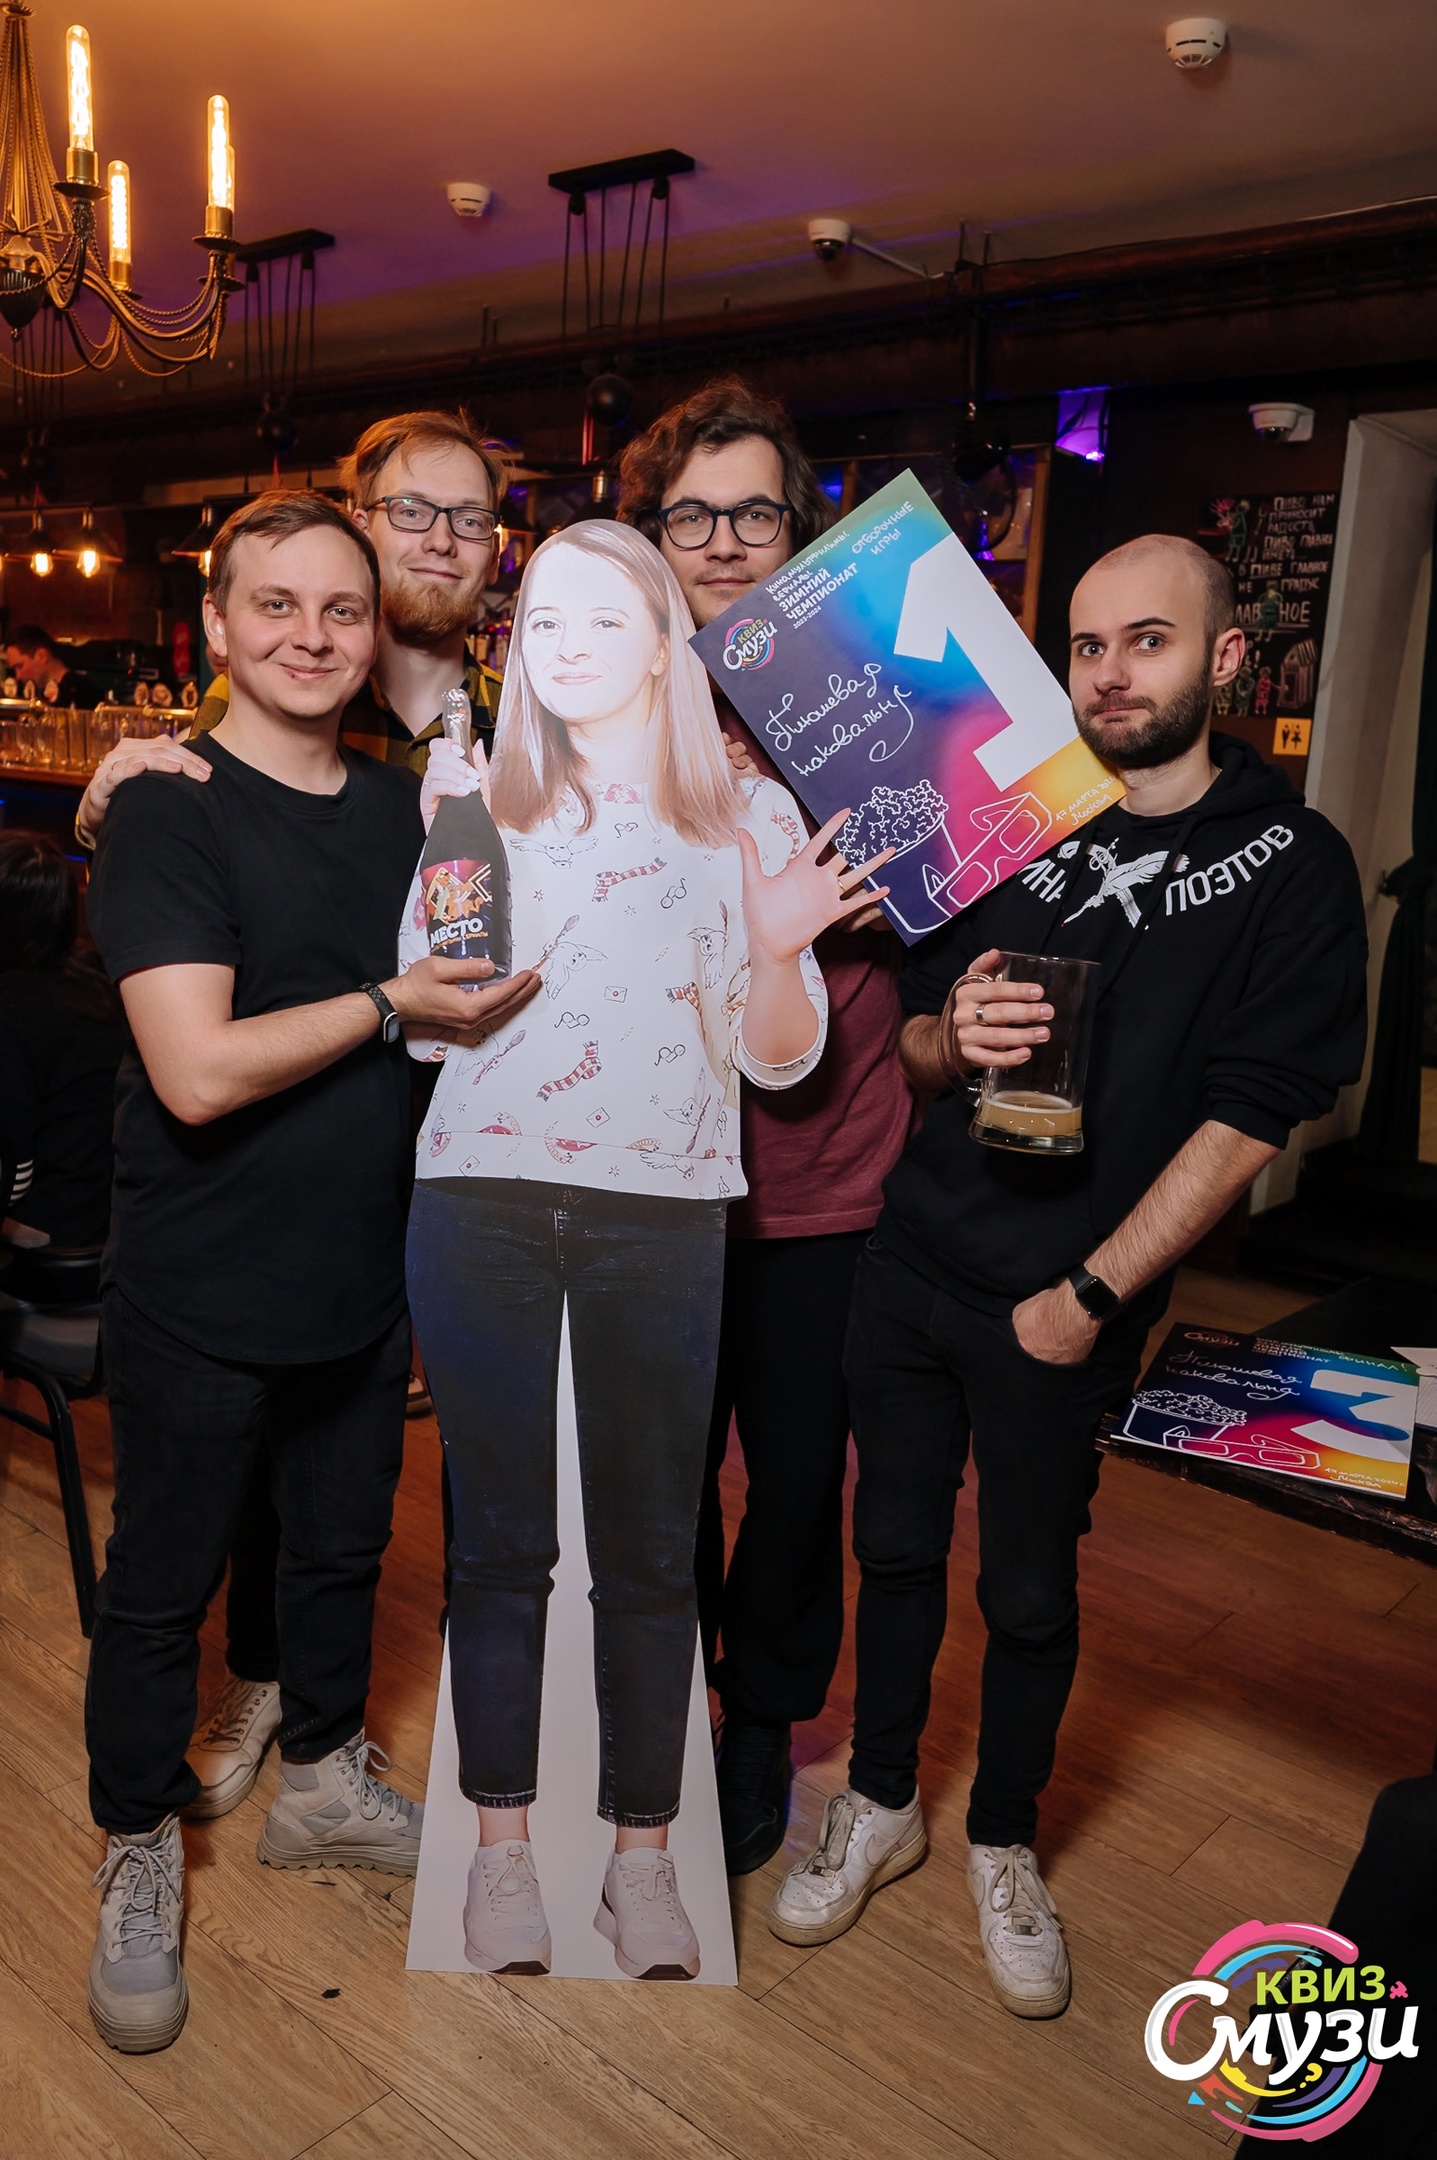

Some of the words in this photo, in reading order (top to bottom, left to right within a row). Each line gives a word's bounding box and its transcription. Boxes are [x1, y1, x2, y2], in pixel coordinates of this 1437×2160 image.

[850, 501, 915, 555] ОТБОРОЧНЫЕ
[870, 528, 903, 556] ИГРЫ
[776, 566, 832, 613] ЗИМНИЙ
[785, 562, 860, 622] ЧЕМПИОНАТ
[1238, 581, 1253, 593] НЕ
[1235, 600, 1312, 623] ЛАВНОЕ
[722, 619, 778, 672] Смузи
[737, 618, 765, 645] КВИЗ
[893, 532, 1080, 792] 1
[1067, 786, 1100, 813] МАРТА
[1165, 824, 1295, 916] ПОЭТОВ
[430, 918, 483, 948] МЕСТО
